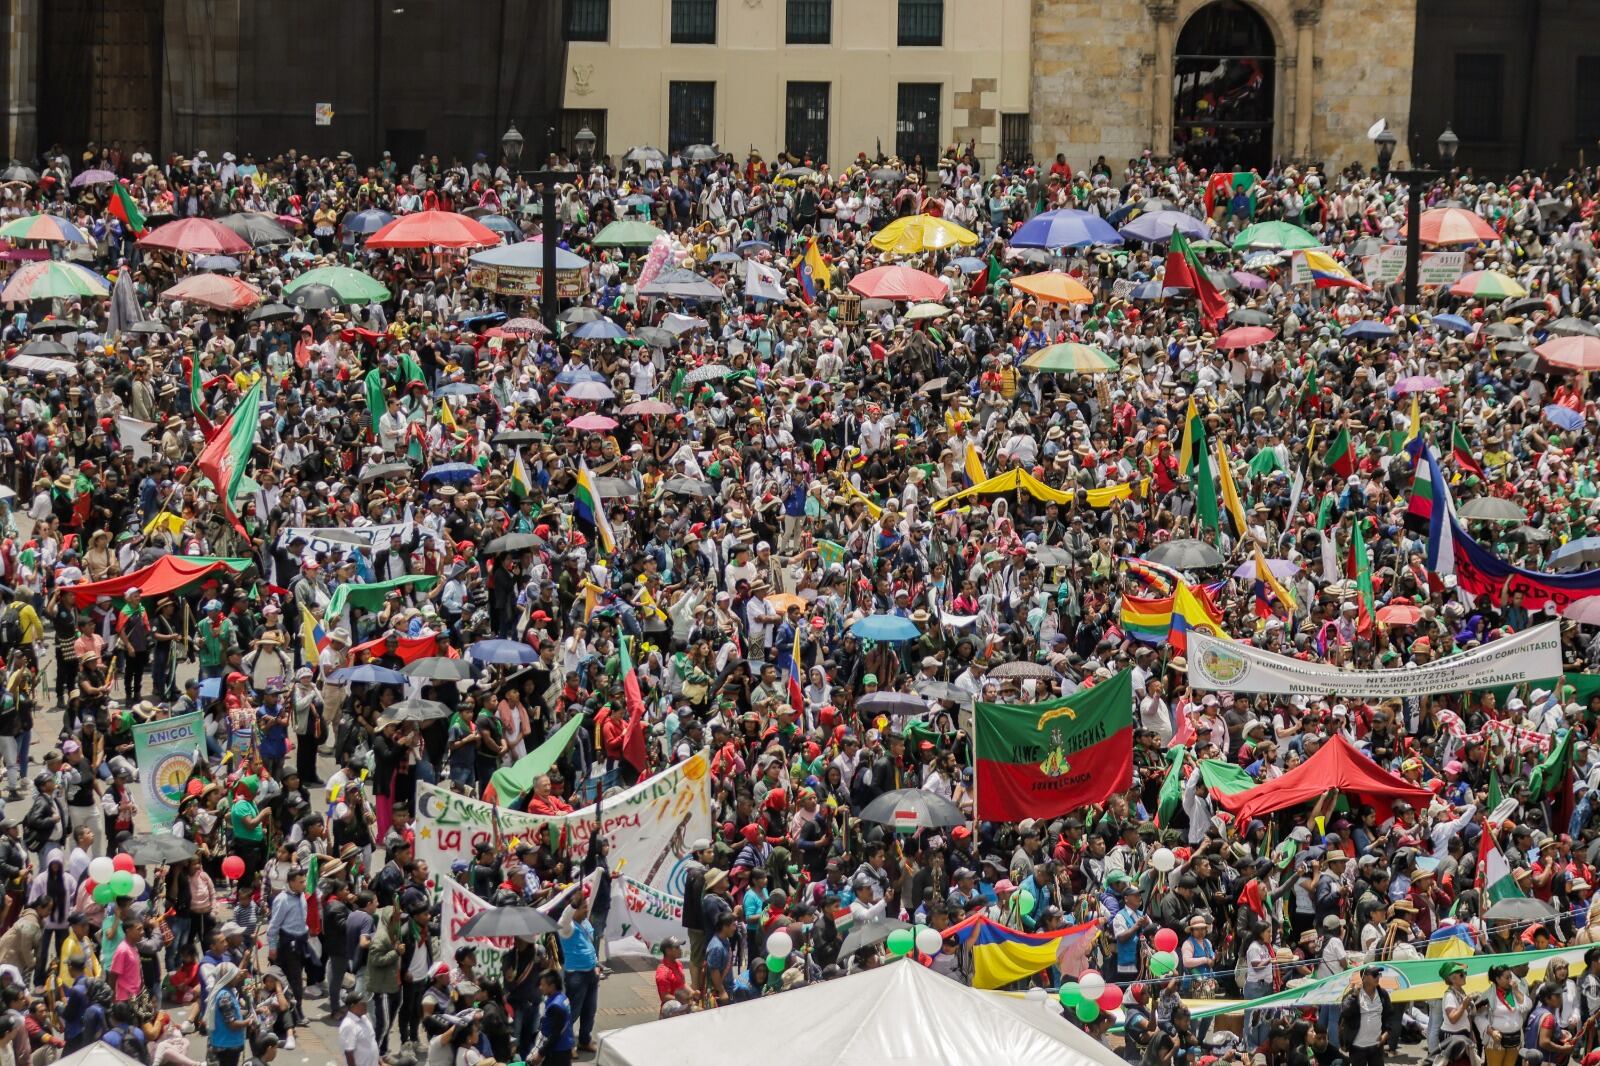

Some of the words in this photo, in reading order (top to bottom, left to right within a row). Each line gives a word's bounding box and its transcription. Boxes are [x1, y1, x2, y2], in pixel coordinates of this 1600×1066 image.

[1495, 640, 1558, 659] COMUNITARIO
[1410, 682, 1458, 693] ARIPORO
[1467, 671, 1526, 686] CASANARE
[1442, 674, 1470, 684] LLANOS
[148, 727, 195, 745] ANICOL
